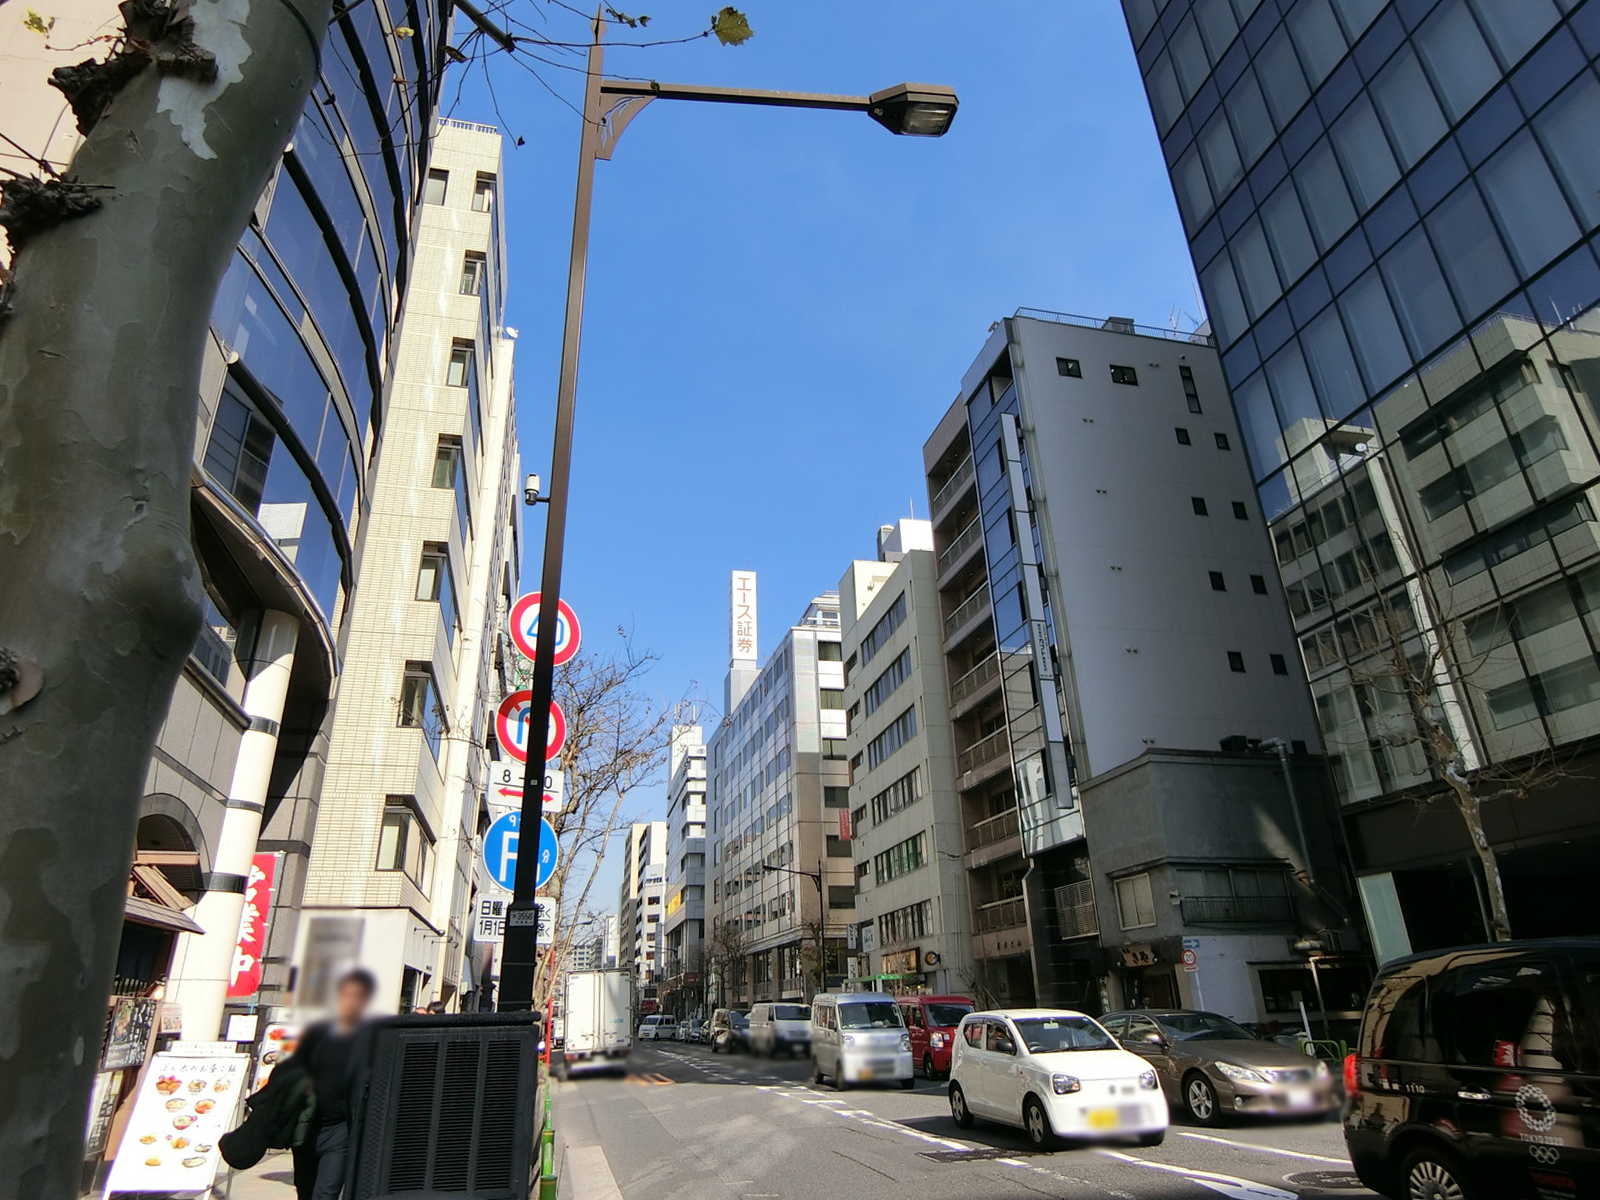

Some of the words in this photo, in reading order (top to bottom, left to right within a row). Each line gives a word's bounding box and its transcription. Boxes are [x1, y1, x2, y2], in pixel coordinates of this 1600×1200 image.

[737, 577, 753, 653] エース証券
